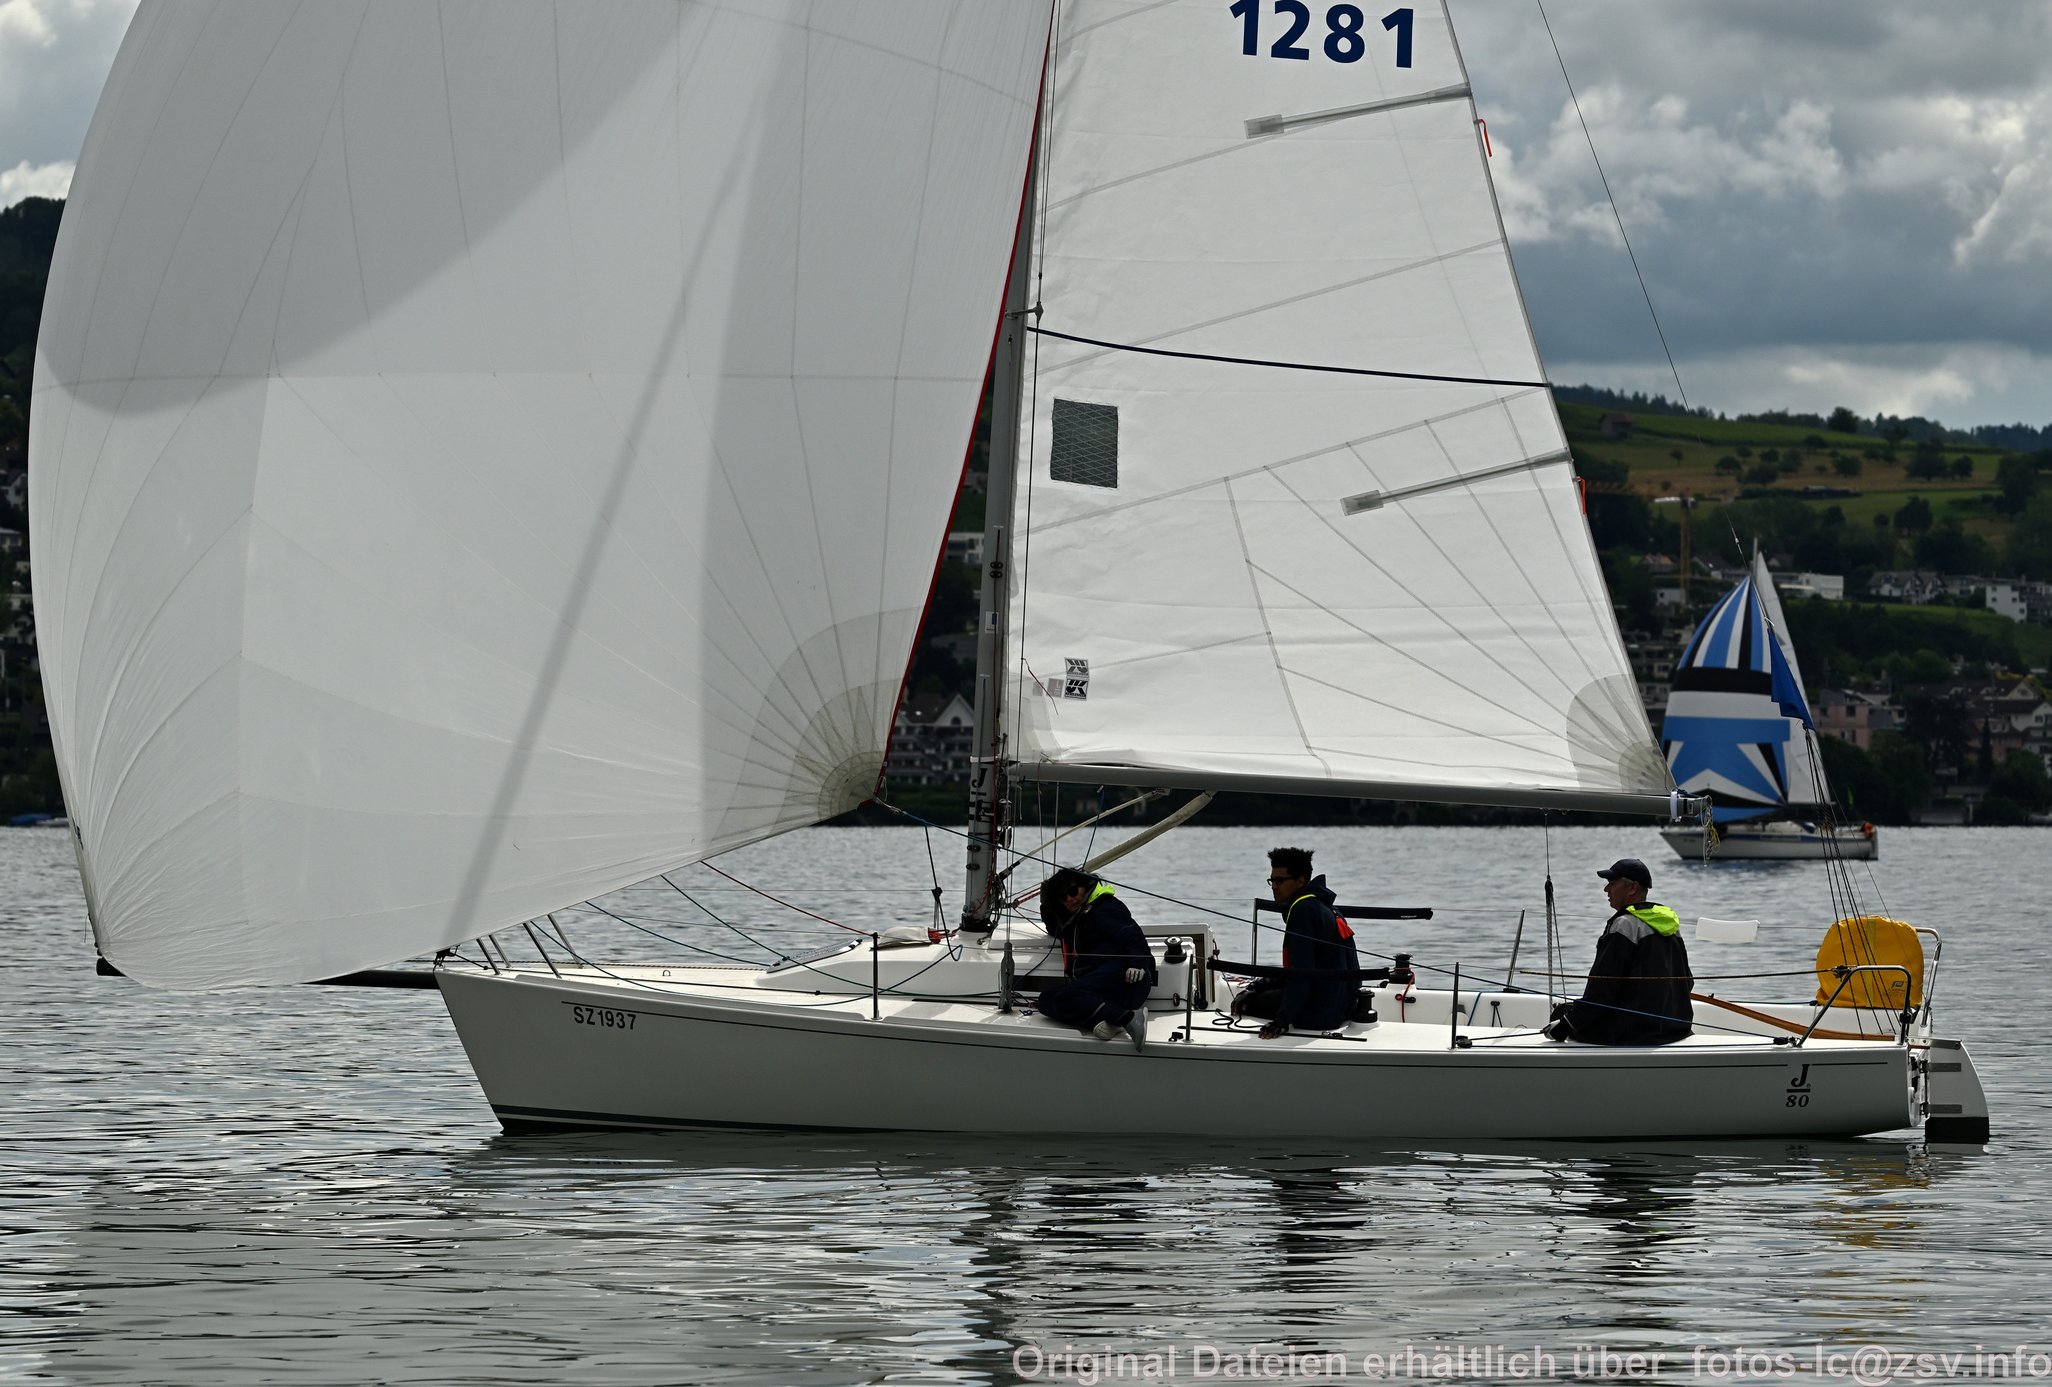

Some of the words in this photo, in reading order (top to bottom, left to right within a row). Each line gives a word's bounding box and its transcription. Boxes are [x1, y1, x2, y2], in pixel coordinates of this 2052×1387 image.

[1229, 0, 1414, 69] 1281
[573, 1005, 637, 1031] SZ1937
[1790, 1063, 1811, 1088] J
[1785, 1094, 1810, 1108] 80
